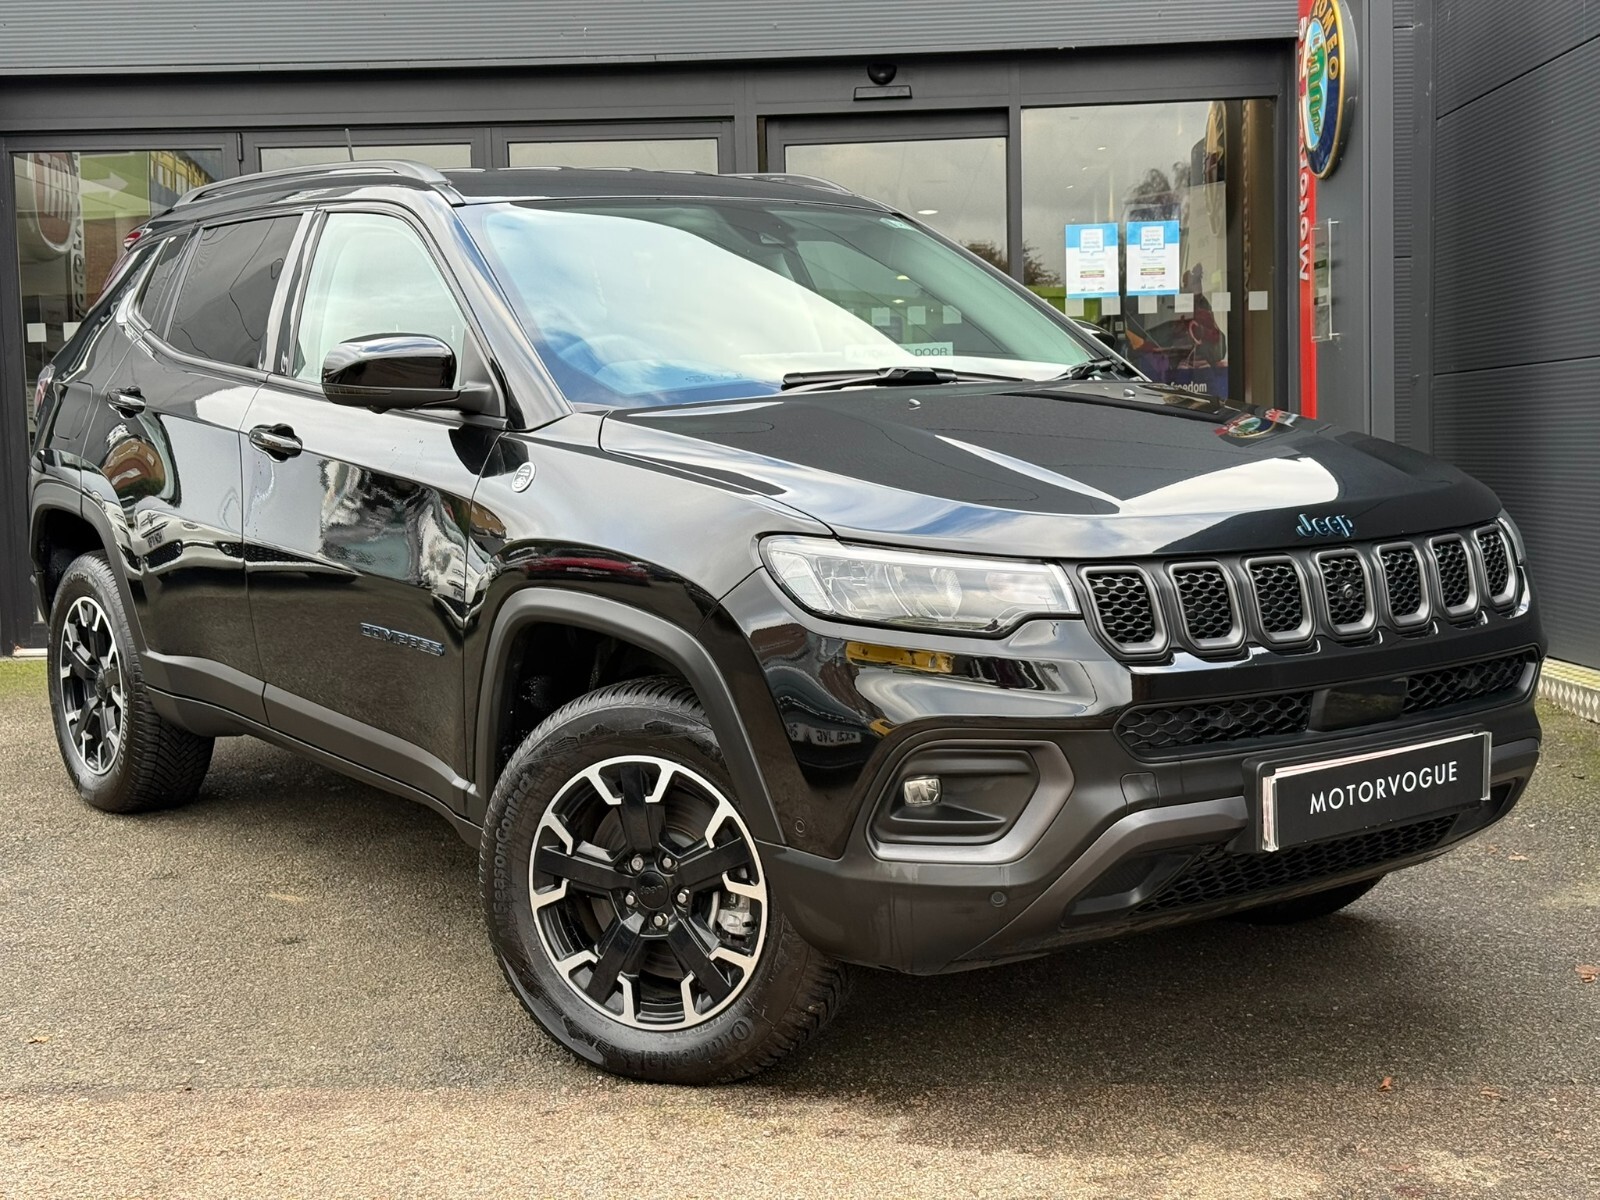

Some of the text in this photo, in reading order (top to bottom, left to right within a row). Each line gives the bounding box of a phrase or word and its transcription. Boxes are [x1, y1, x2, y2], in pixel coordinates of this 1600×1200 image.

[915, 348, 948, 357] DOOR
[1296, 513, 1355, 538] Jeep
[360, 622, 445, 657] COMPASS
[1309, 761, 1458, 815] MOTORVOGUE
